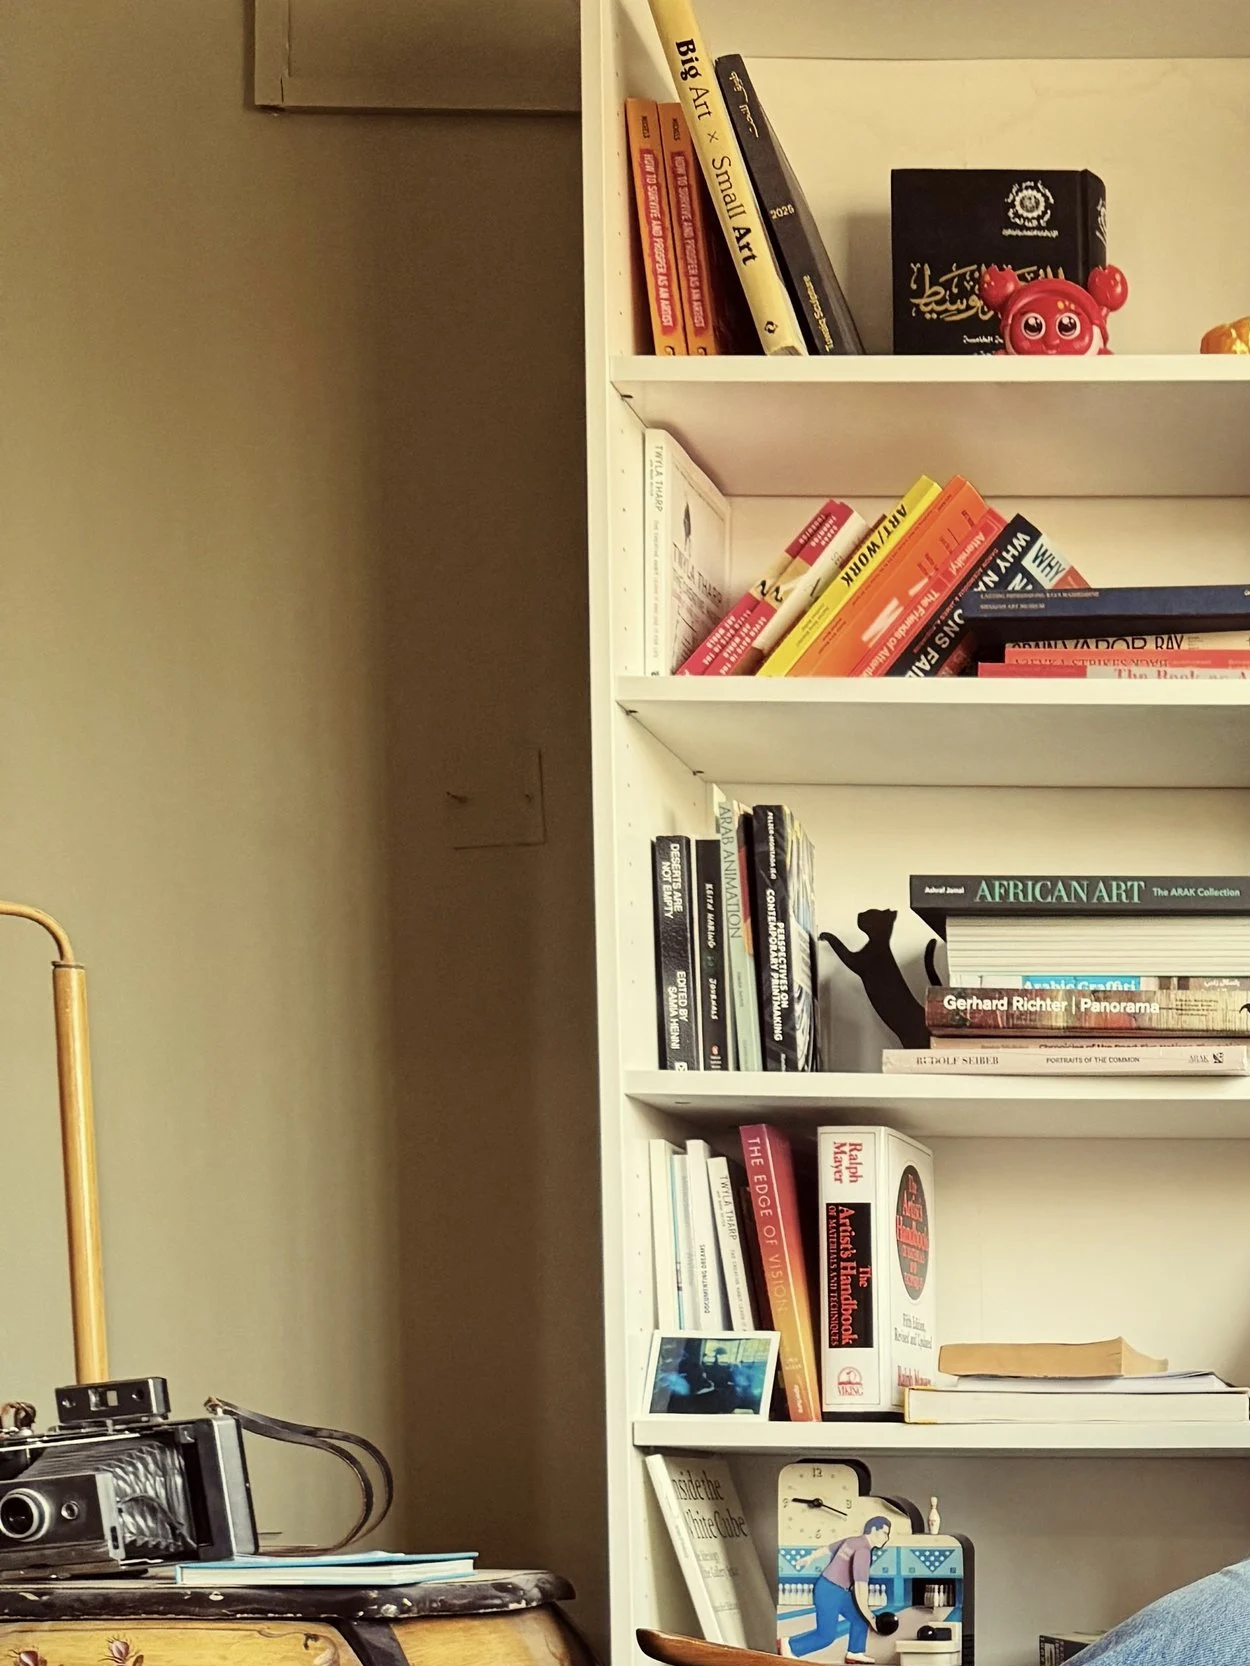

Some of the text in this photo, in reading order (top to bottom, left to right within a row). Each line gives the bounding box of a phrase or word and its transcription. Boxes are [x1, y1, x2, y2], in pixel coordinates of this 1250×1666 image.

[671, 37, 761, 265] Big Art Small Art
[643, 153, 673, 327] HOW TO SURVIVE AND PROSPER AS AN ARTIST
[673, 156, 705, 328] HOW TO SURVIVE AND PROSPER AS AN ARTIST
[654, 445, 663, 512] TWYLA THARP
[839, 502, 910, 587] ART/WORK
[945, 527, 986, 577] Attensity!
[993, 529, 1030, 574] WHY
[1032, 543, 1066, 583] WHY
[706, 614, 736, 649] ART WORLD
[719, 627, 735, 644] DAYS
[722, 622, 751, 657] ART WORLD
[884, 587, 940, 652] The Friends of
[702, 651, 715, 665] THE
[712, 642, 721, 652] IN
[718, 615, 767, 675] SEVEN DAYS IN THE
[1154, 634, 1185, 650] RAY
[661, 861, 673, 919] NOT EMPTY
[669, 843, 683, 912] DESERTS ARE
[717, 805, 743, 939] ARAB ANIMATION
[924, 886, 965, 895] Ashraf Jamal
[974, 879, 1146, 903] AFRICAN ART
[1152, 887, 1241, 897] The ARAK Collection
[704, 882, 716, 948] KEITH HARING
[765, 888, 782, 1041] CONTEMPORARY PRINTMAKING
[775, 921, 788, 1008] PERSPECTIVES ON
[1022, 980, 1136, 991] Arabic Graffiti
[667, 986, 680, 1049] SAMIA HENNI
[676, 971, 688, 1022] EDITED BY
[707, 977, 719, 1019] JOURNALS
[943, 995, 1008, 1012] Gerhard
[1012, 996, 1068, 1013] Richter
[1080, 997, 1161, 1014] Panorama
[915, 1056, 957, 1065] RUDOLF
[1046, 1056, 1083, 1064] PORTRAITS
[1108, 1056, 1141, 1064] COMMON
[828, 1140, 849, 1184] Mayer
[844, 1141, 865, 1183] Ralph
[716, 1174, 739, 1241] TWYLA THARP
[745, 1136, 791, 1312] THE EDGE OF VISION
[895, 1214, 930, 1251] Handbook
[697, 1243, 711, 1313] DOCUMENTING DREAMS
[827, 1205, 840, 1345] OF MATERIALS AND TECHNIQUES
[837, 1205, 859, 1344] Artist's Handbook
[858, 1265, 871, 1287] The
[894, 1326, 910, 1344] Revised
[837, 1385, 864, 1396] VIKING
[897, 1365, 913, 1388] Ralph
[702, 1470, 725, 1501] the
[713, 1508, 749, 1538] Cube
